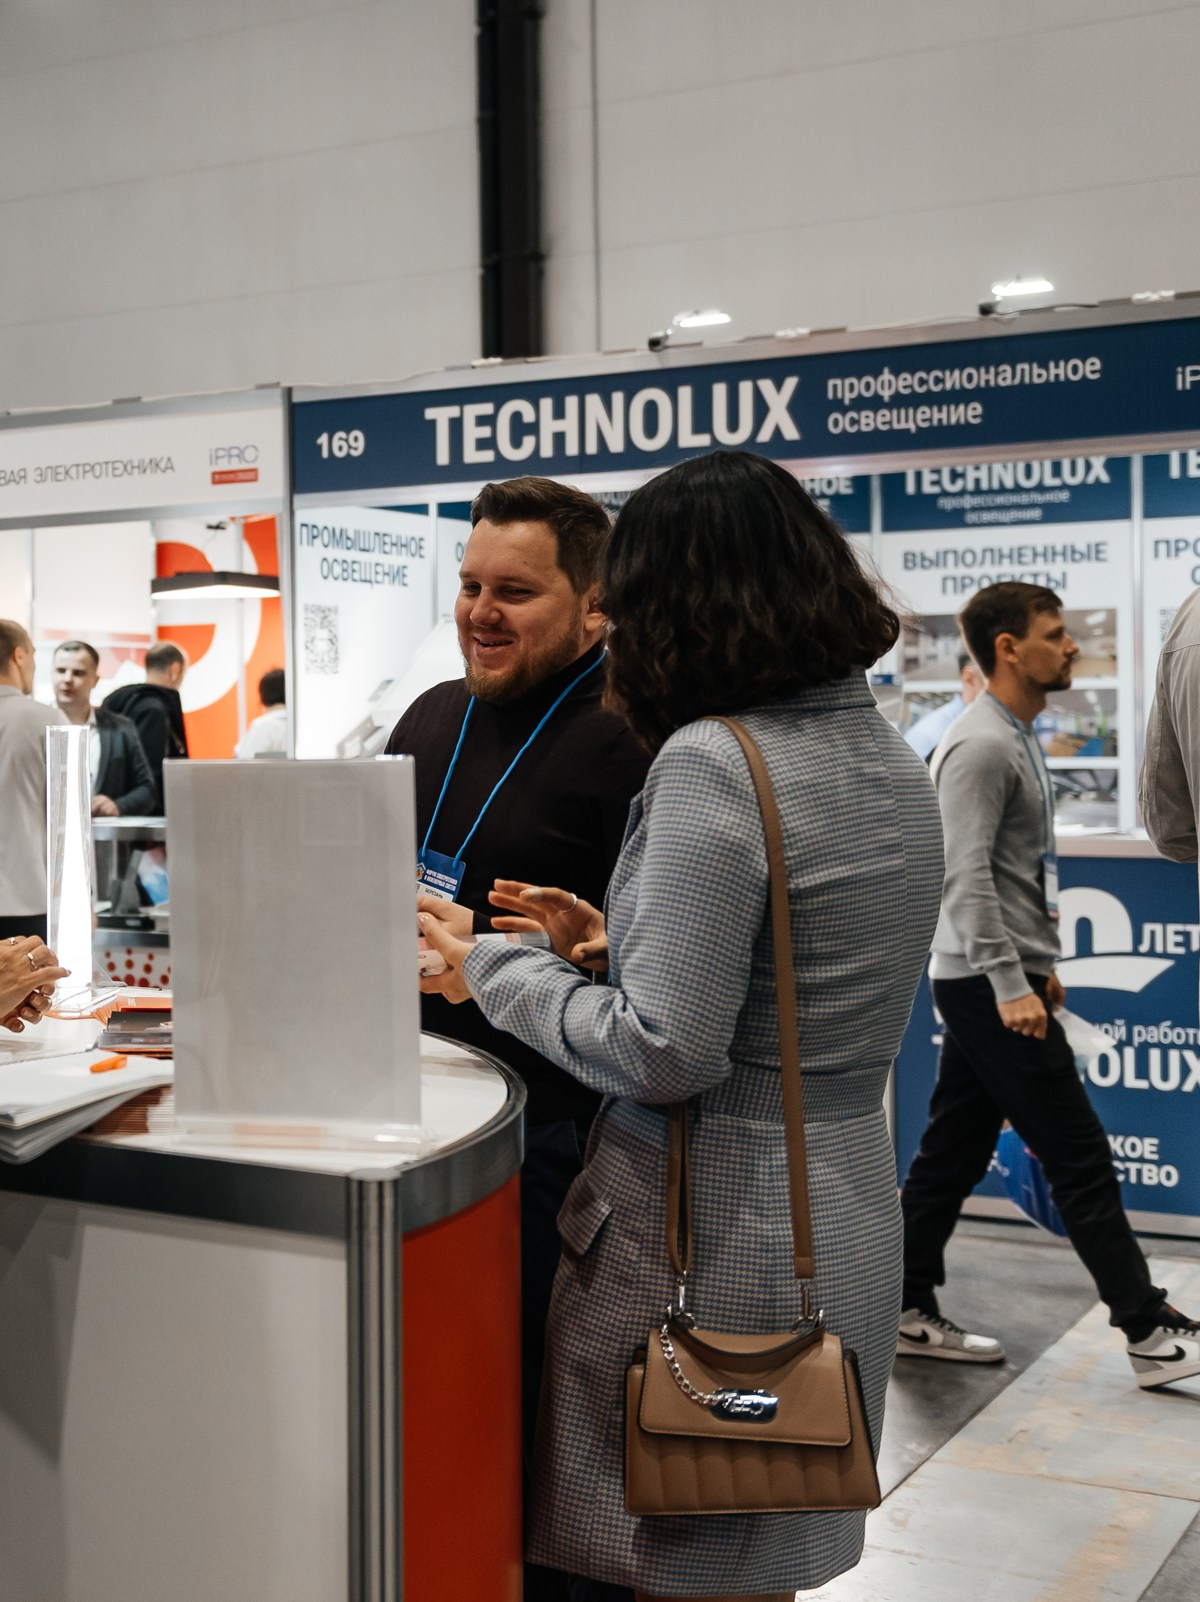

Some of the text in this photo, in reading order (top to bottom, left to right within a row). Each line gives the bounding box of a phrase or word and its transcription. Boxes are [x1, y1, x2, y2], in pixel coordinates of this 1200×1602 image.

[827, 356, 1101, 405] профессиональное
[424, 376, 801, 466] TECHNOLUX
[827, 402, 983, 434] освещение
[208, 444, 259, 466] iPRO
[316, 430, 365, 459] 169
[33, 456, 176, 484] ЭЛЕКТРОТЕХНИКА
[801, 477, 854, 496] НОЕ
[937, 488, 1071, 510] профессиональное
[964, 507, 1043, 524] освещение
[299, 522, 426, 559] ПРОМЫШЛЕННОЕ
[903, 540, 1109, 571] ВЫПОЛНЕННЫЕ
[320, 557, 409, 588] ОСВЕЩЕНИЕ
[1094, 1018, 1126, 1042] ой
[1083, 1045, 1200, 1093] OLUX
